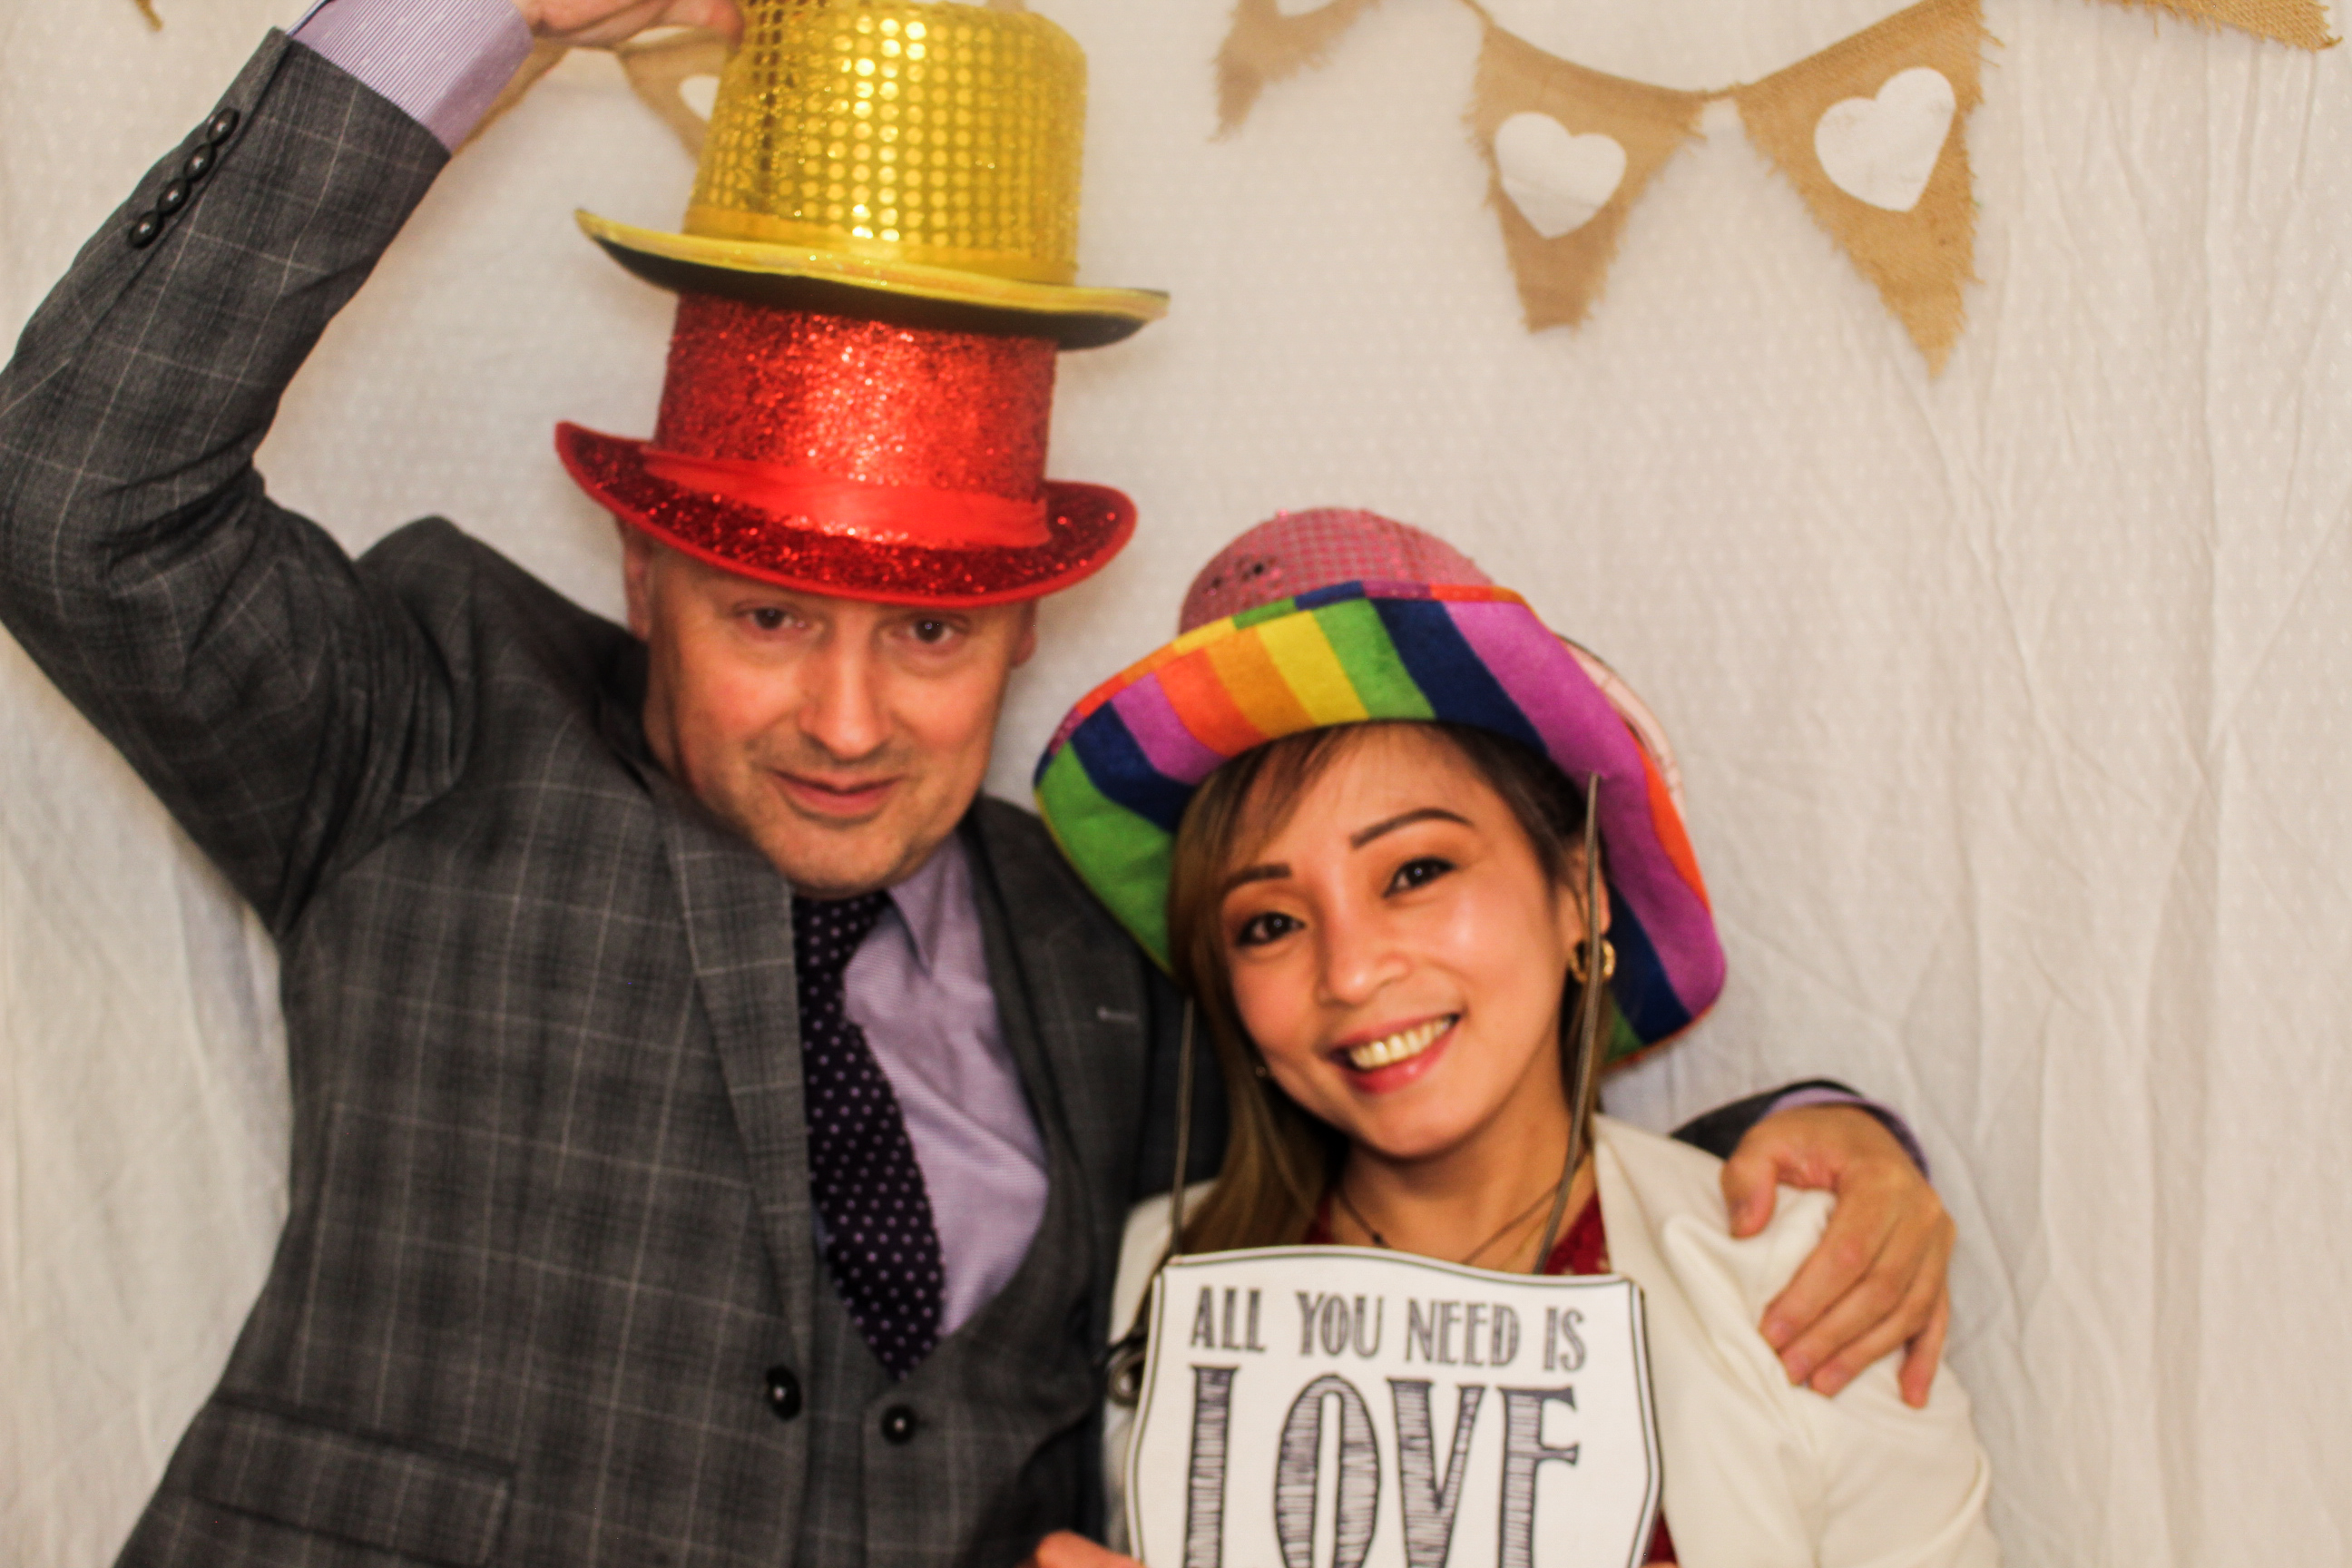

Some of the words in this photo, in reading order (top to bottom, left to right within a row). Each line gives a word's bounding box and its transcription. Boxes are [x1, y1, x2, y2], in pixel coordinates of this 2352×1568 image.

[1191, 1286, 1267, 1352] ALL
[1296, 1291, 1383, 1359] YOU
[1406, 1298, 1521, 1367] NEED
[1544, 1306, 1587, 1373] IS
